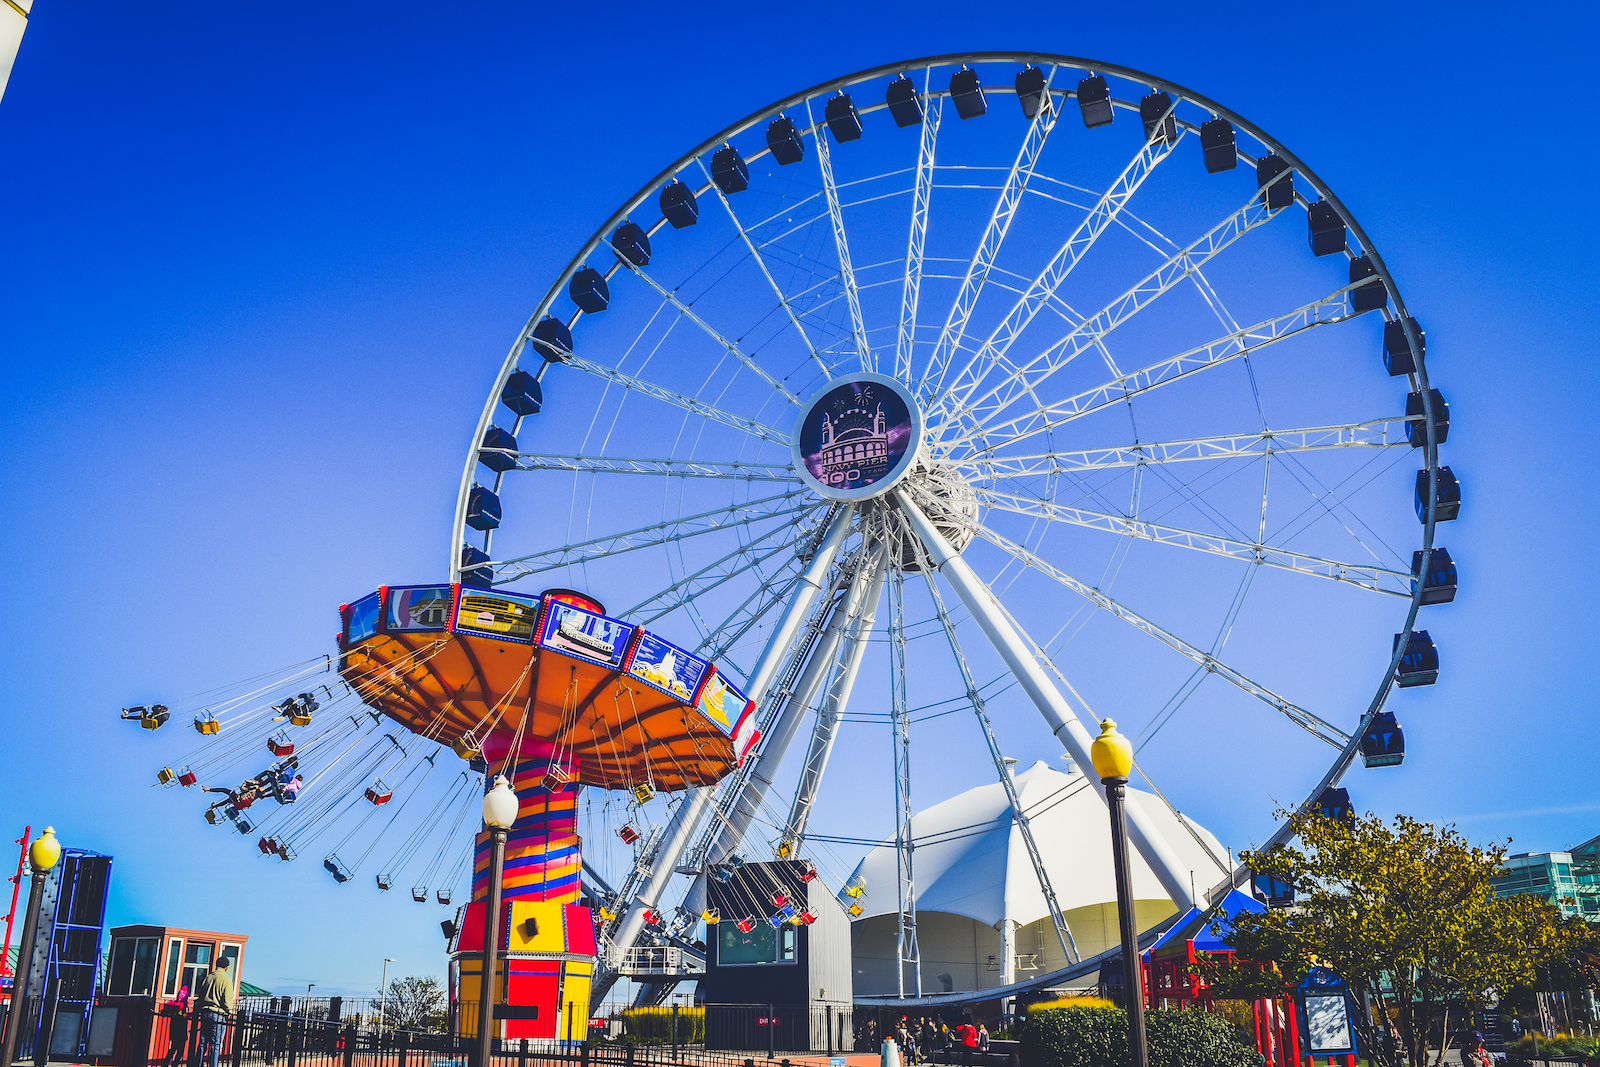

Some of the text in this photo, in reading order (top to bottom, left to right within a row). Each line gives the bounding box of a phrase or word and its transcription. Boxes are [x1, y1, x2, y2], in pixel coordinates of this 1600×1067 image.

[822, 456, 888, 473] NAVY PIER
[822, 469, 860, 484] 100
